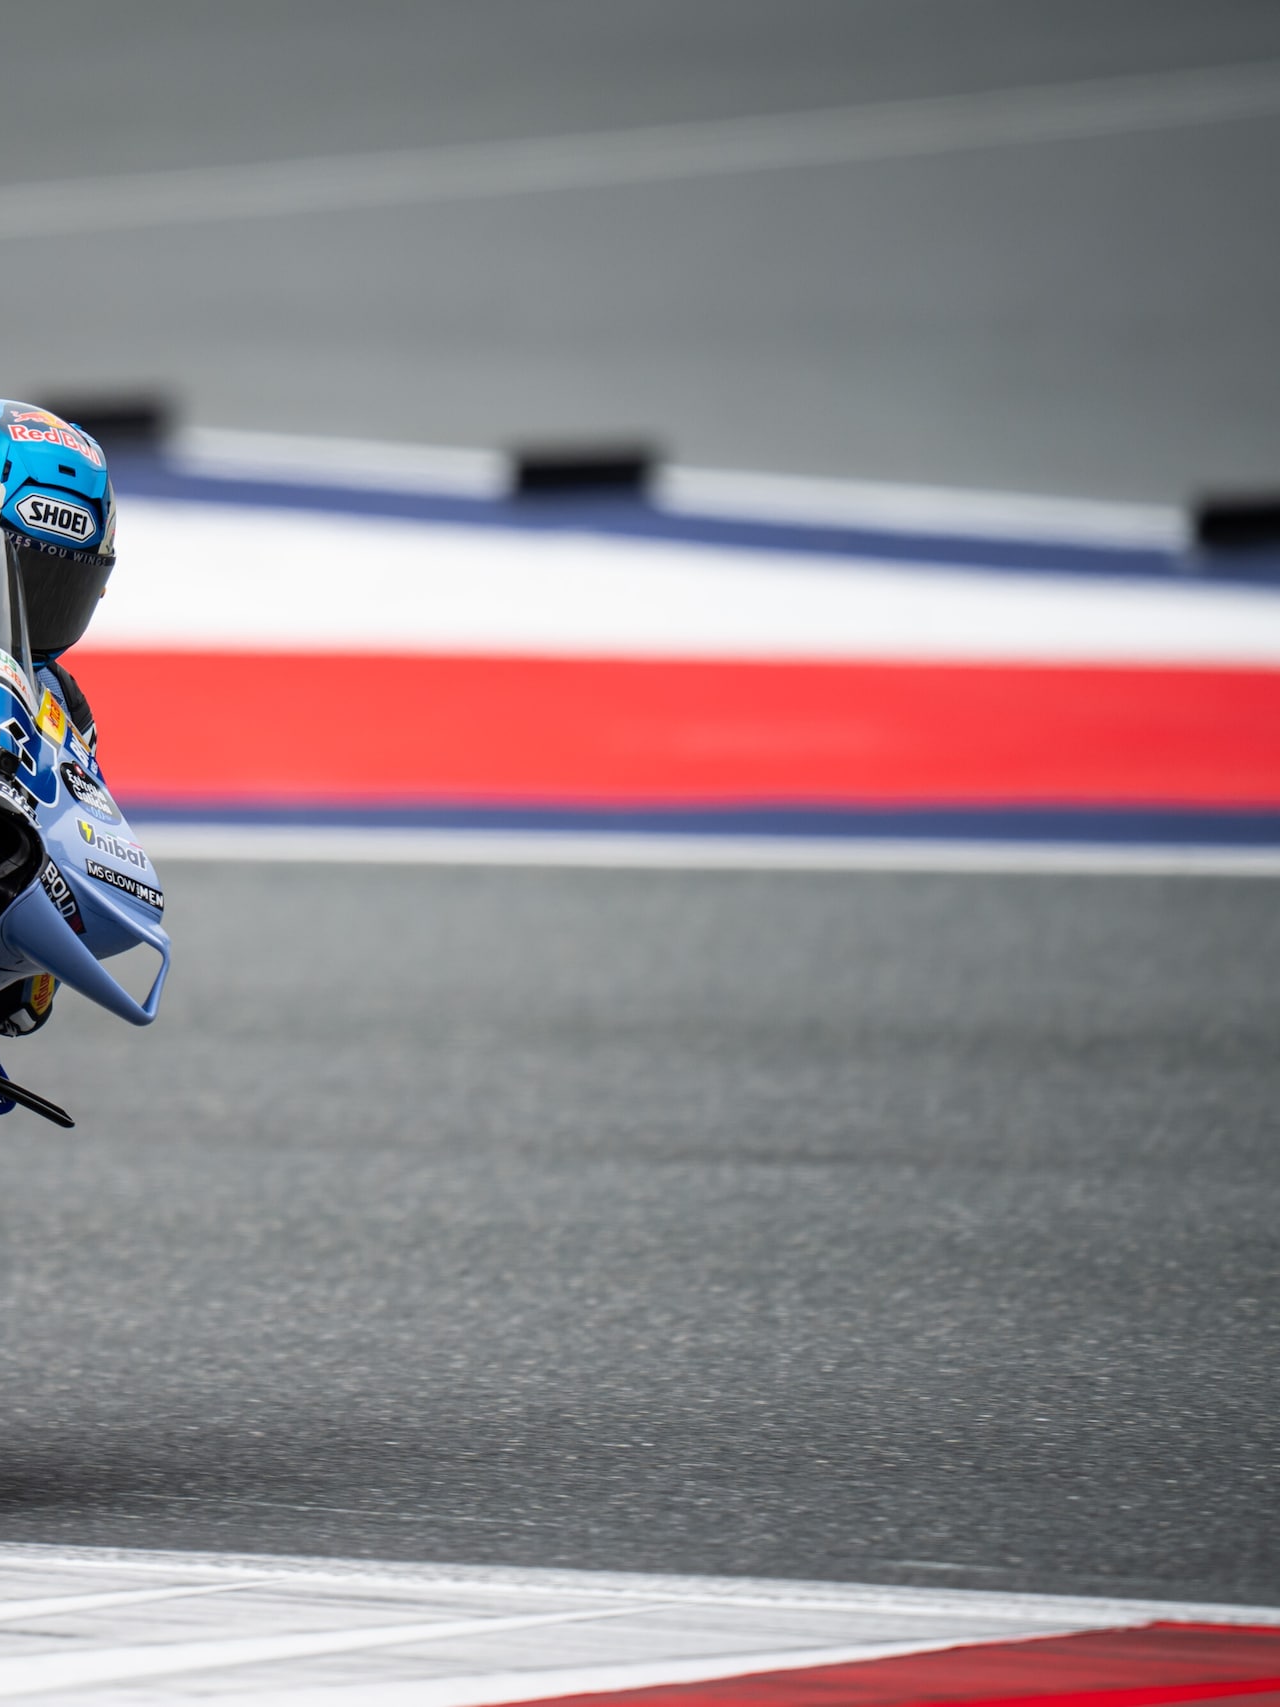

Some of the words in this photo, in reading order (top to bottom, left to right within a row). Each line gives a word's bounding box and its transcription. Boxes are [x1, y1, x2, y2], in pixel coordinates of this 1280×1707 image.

[8, 425, 62, 445] Red
[60, 430, 102, 467] Bull
[29, 500, 87, 535] SHOEI
[40, 542, 67, 558] YOU
[74, 551, 107, 567] WINGS
[77, 819, 147, 871] Unibat
[45, 861, 77, 918] BOLD
[105, 870, 136, 893] GLOW
